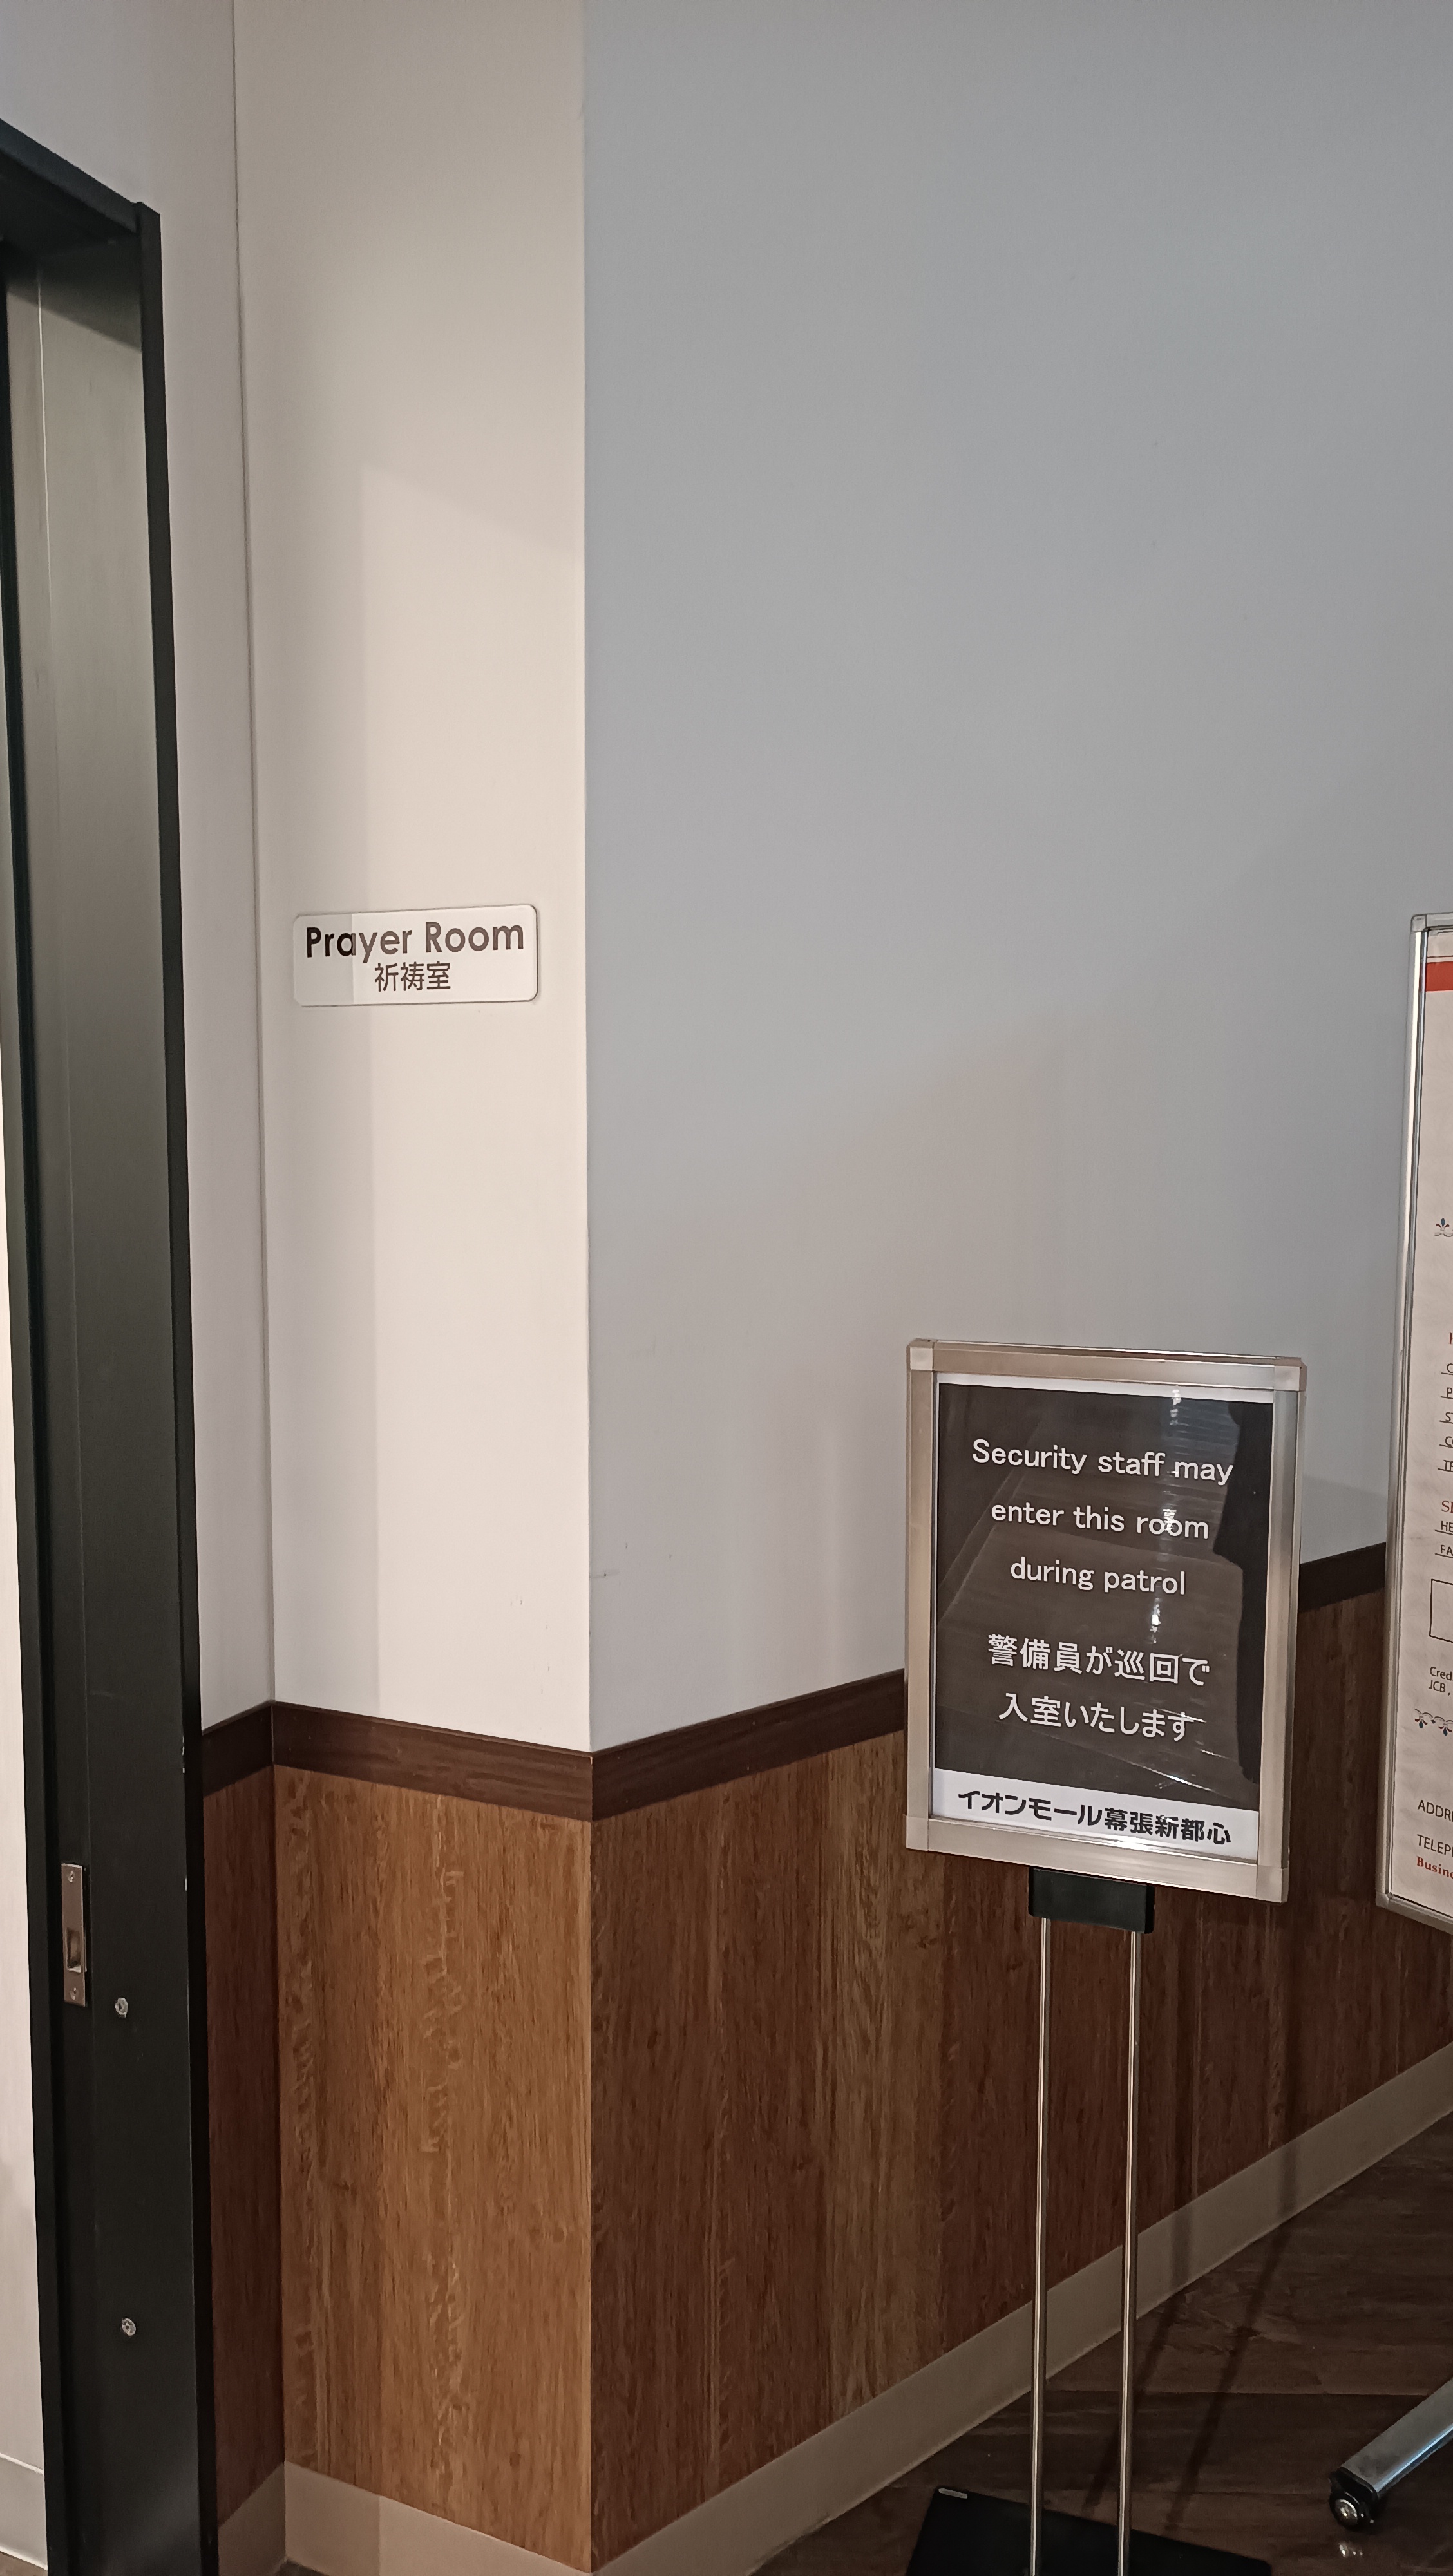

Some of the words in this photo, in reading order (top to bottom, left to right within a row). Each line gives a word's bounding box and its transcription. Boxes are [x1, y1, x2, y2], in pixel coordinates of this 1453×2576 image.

[306, 926, 412, 964] Prayer
[425, 921, 524, 953] Room
[374, 960, 451, 992] 祈祷室
[971, 1438, 1088, 1475] Security
[1097, 1451, 1166, 1477] staff
[1174, 1460, 1234, 1486] may
[991, 1502, 1065, 1526] enter
[1073, 1505, 1125, 1531] this
[1136, 1515, 1209, 1539] room
[1010, 1556, 1095, 1591] during
[1103, 1569, 1186, 1595] patrol
[987, 1633, 1210, 1686] 警備員が巡回で
[1429, 1666, 1453, 1681] Cred
[998, 1692, 1195, 1741] 入室いたします
[958, 1790, 1231, 1845] イオンモール幕張新都心
[1417, 1799, 1453, 1822] ADDR
[1416, 1833, 1453, 1857] TELEP
